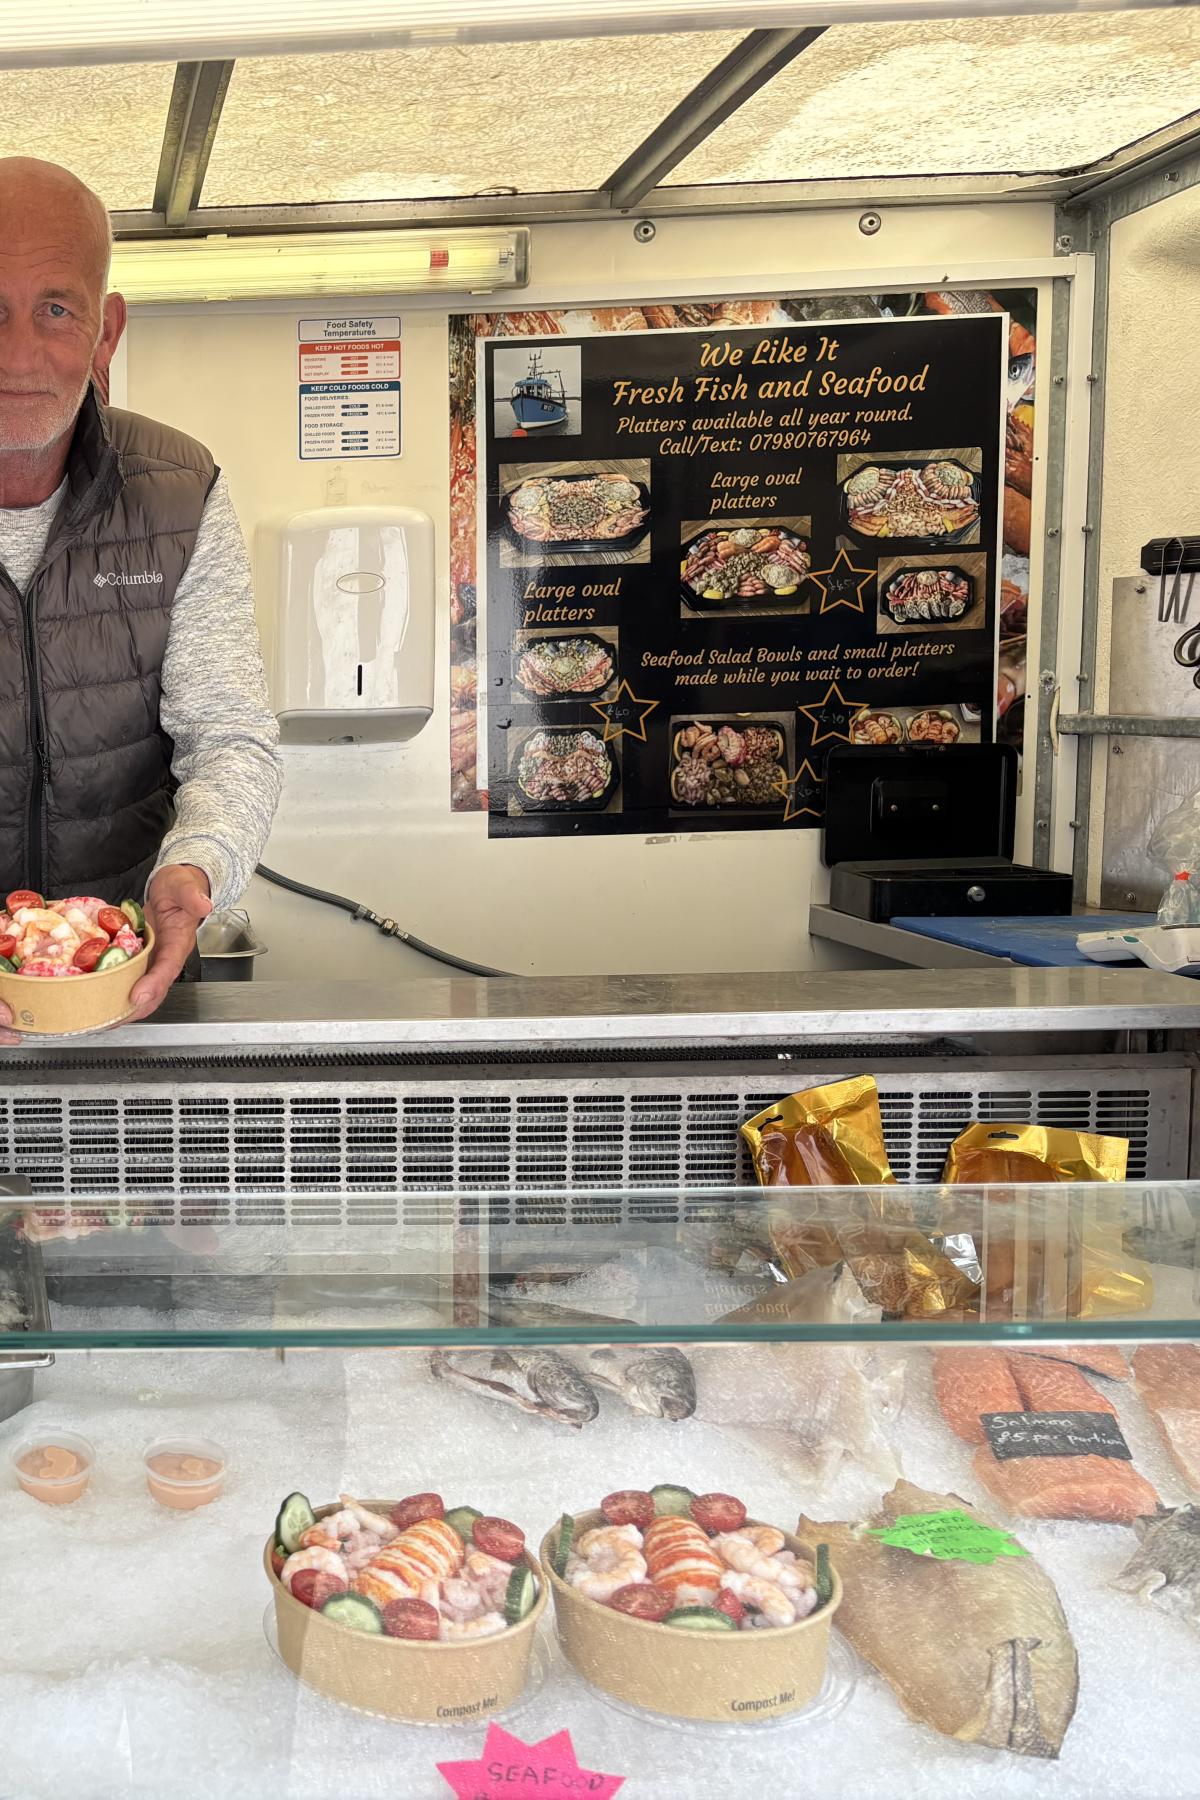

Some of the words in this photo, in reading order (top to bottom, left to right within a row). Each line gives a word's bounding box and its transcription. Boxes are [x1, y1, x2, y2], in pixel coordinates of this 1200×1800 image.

[324, 329, 376, 338] Temperatures
[349, 320, 373, 329] Safety
[700, 342, 742, 368] We
[751, 337, 807, 365] Like
[816, 336, 840, 362] It
[612, 377, 684, 406] Fresh
[694, 373, 748, 403] Fish
[758, 370, 812, 399] and
[818, 364, 930, 398] Seafood
[616, 415, 685, 434] Platters
[691, 409, 774, 433] available
[779, 408, 801, 427] all
[808, 411, 850, 431] year
[855, 403, 913, 423] round.
[659, 434, 742, 457] Call/Text:
[749, 429, 871, 451] 07980767964
[710, 471, 759, 492] Large
[765, 467, 803, 485] oval
[709, 492, 777, 515] platters
[106, 570, 163, 586] Columbia
[523, 581, 576, 603] Large
[581, 577, 622, 597] oval
[523, 603, 595, 627] platters
[641, 651, 705, 668] Seafood
[708, 648, 752, 665] Salad
[757, 646, 802, 663] Bowls
[808, 644, 839, 661] and
[842, 642, 887, 660] small
[891, 641, 955, 661] platters
[675, 669, 718, 686] made
[723, 667, 766, 684] while
[770, 671, 800, 687] you
[805, 667, 841, 682] wait
[846, 666, 862, 680] to
[867, 661, 919, 679] order!
[991, 1415, 1073, 1429] Salmon
[1033, 1434, 1058, 1443] per
[1067, 1433, 1125, 1445] portion
[436, 1702, 481, 1718] Compost
[482, 1695, 498, 1708] Me!
[730, 1697, 776, 1713] Compost
[776, 1689, 796, 1706] Me!
[487, 1761, 605, 1790] SEAFOOD
